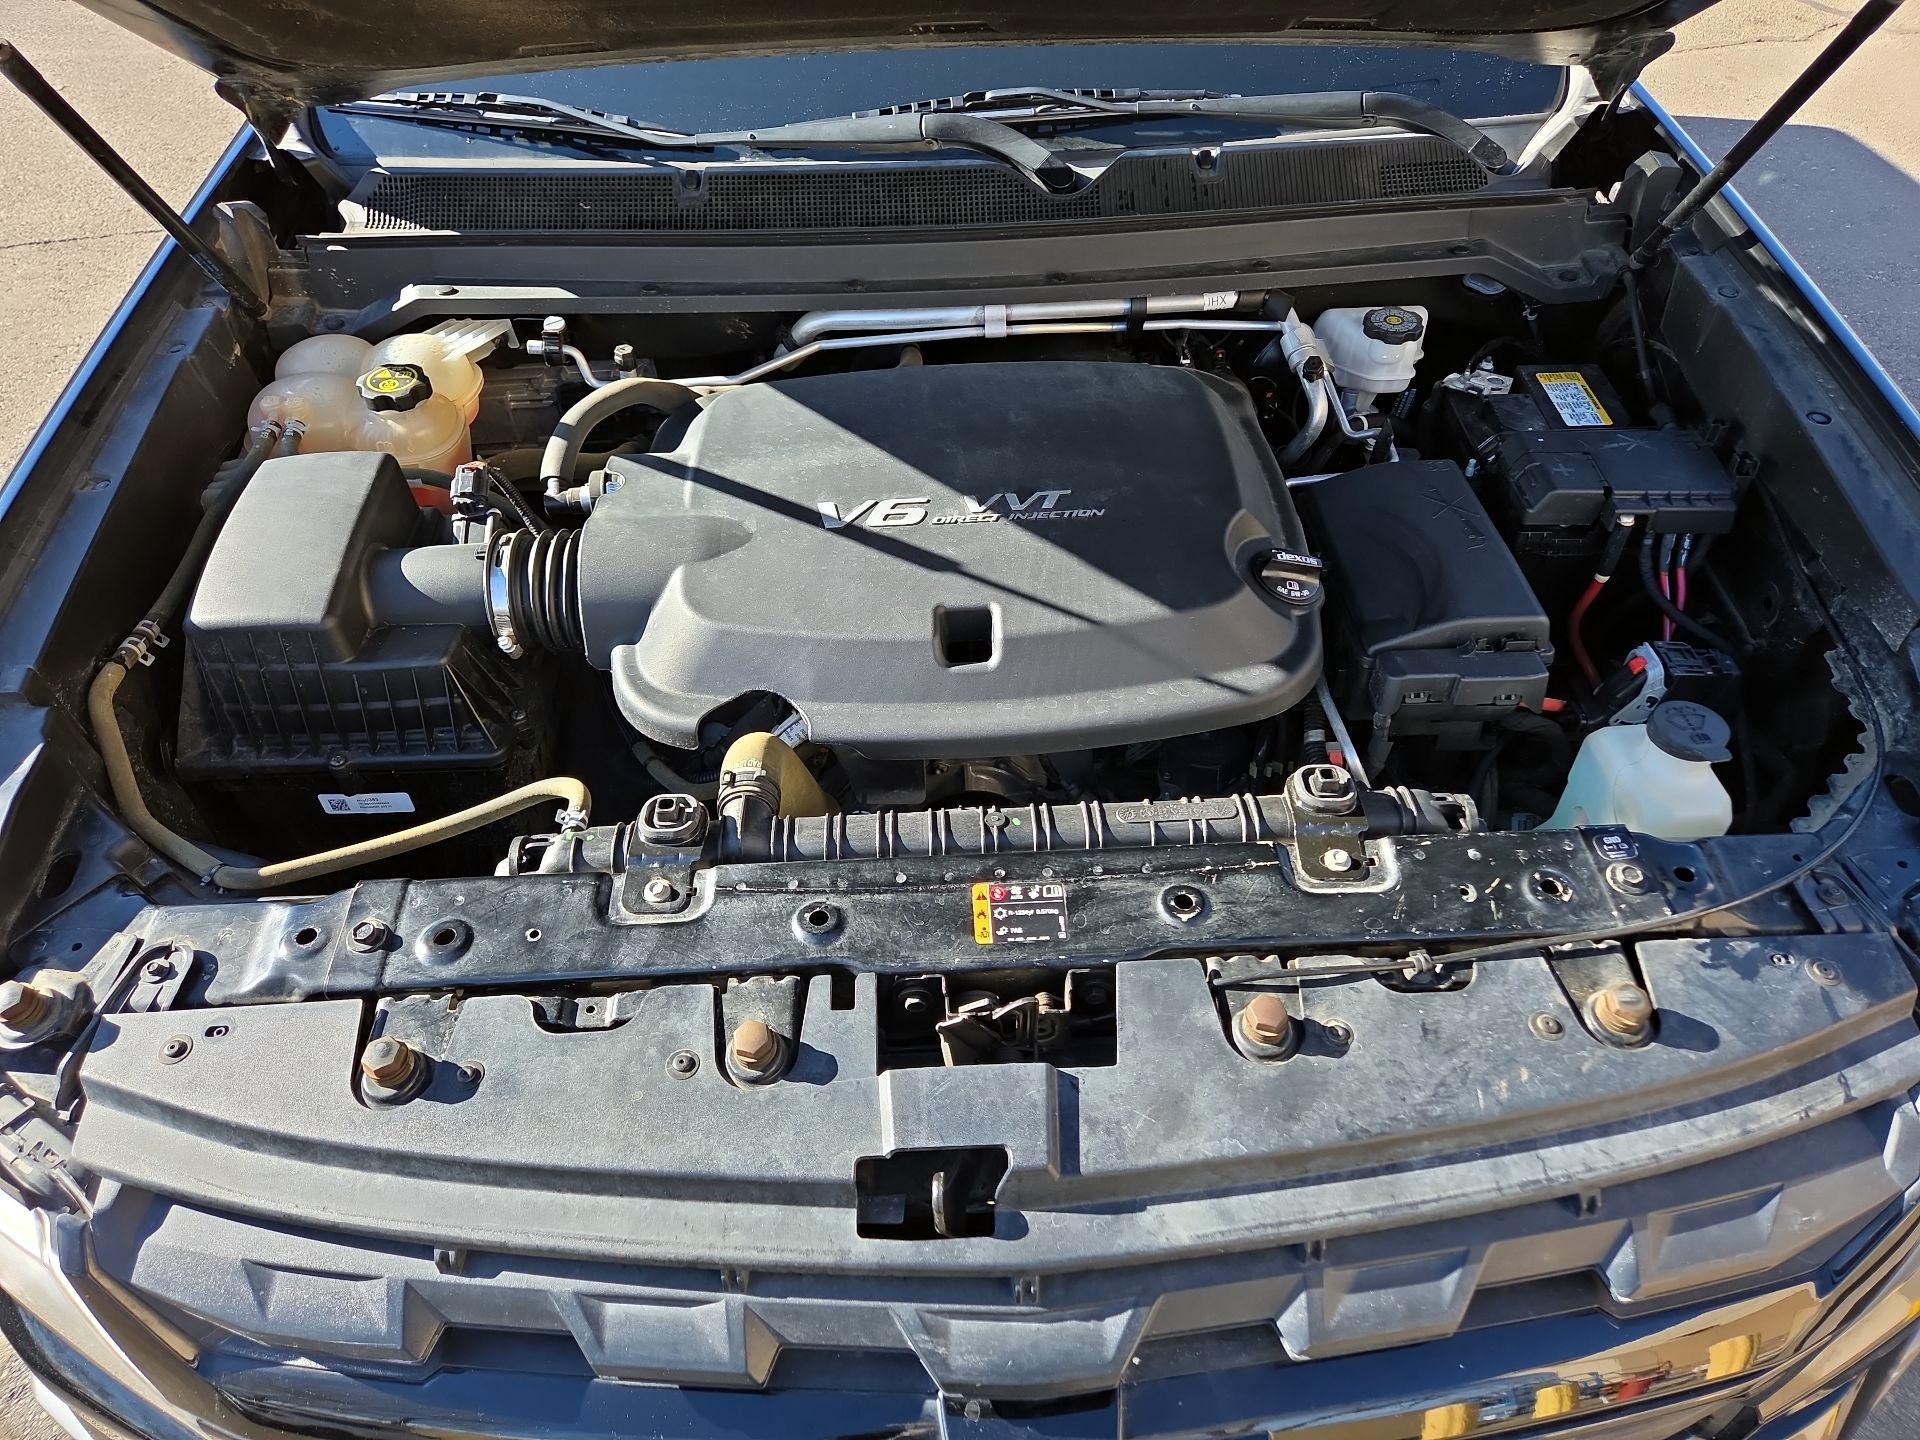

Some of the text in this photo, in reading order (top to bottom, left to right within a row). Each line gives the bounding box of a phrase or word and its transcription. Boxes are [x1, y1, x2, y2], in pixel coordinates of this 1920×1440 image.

[962, 489, 1072, 513] VVT
[816, 497, 931, 530] V6
[931, 508, 1105, 525] DIRECT INJECTION
[1276, 551, 1318, 566] dexos
